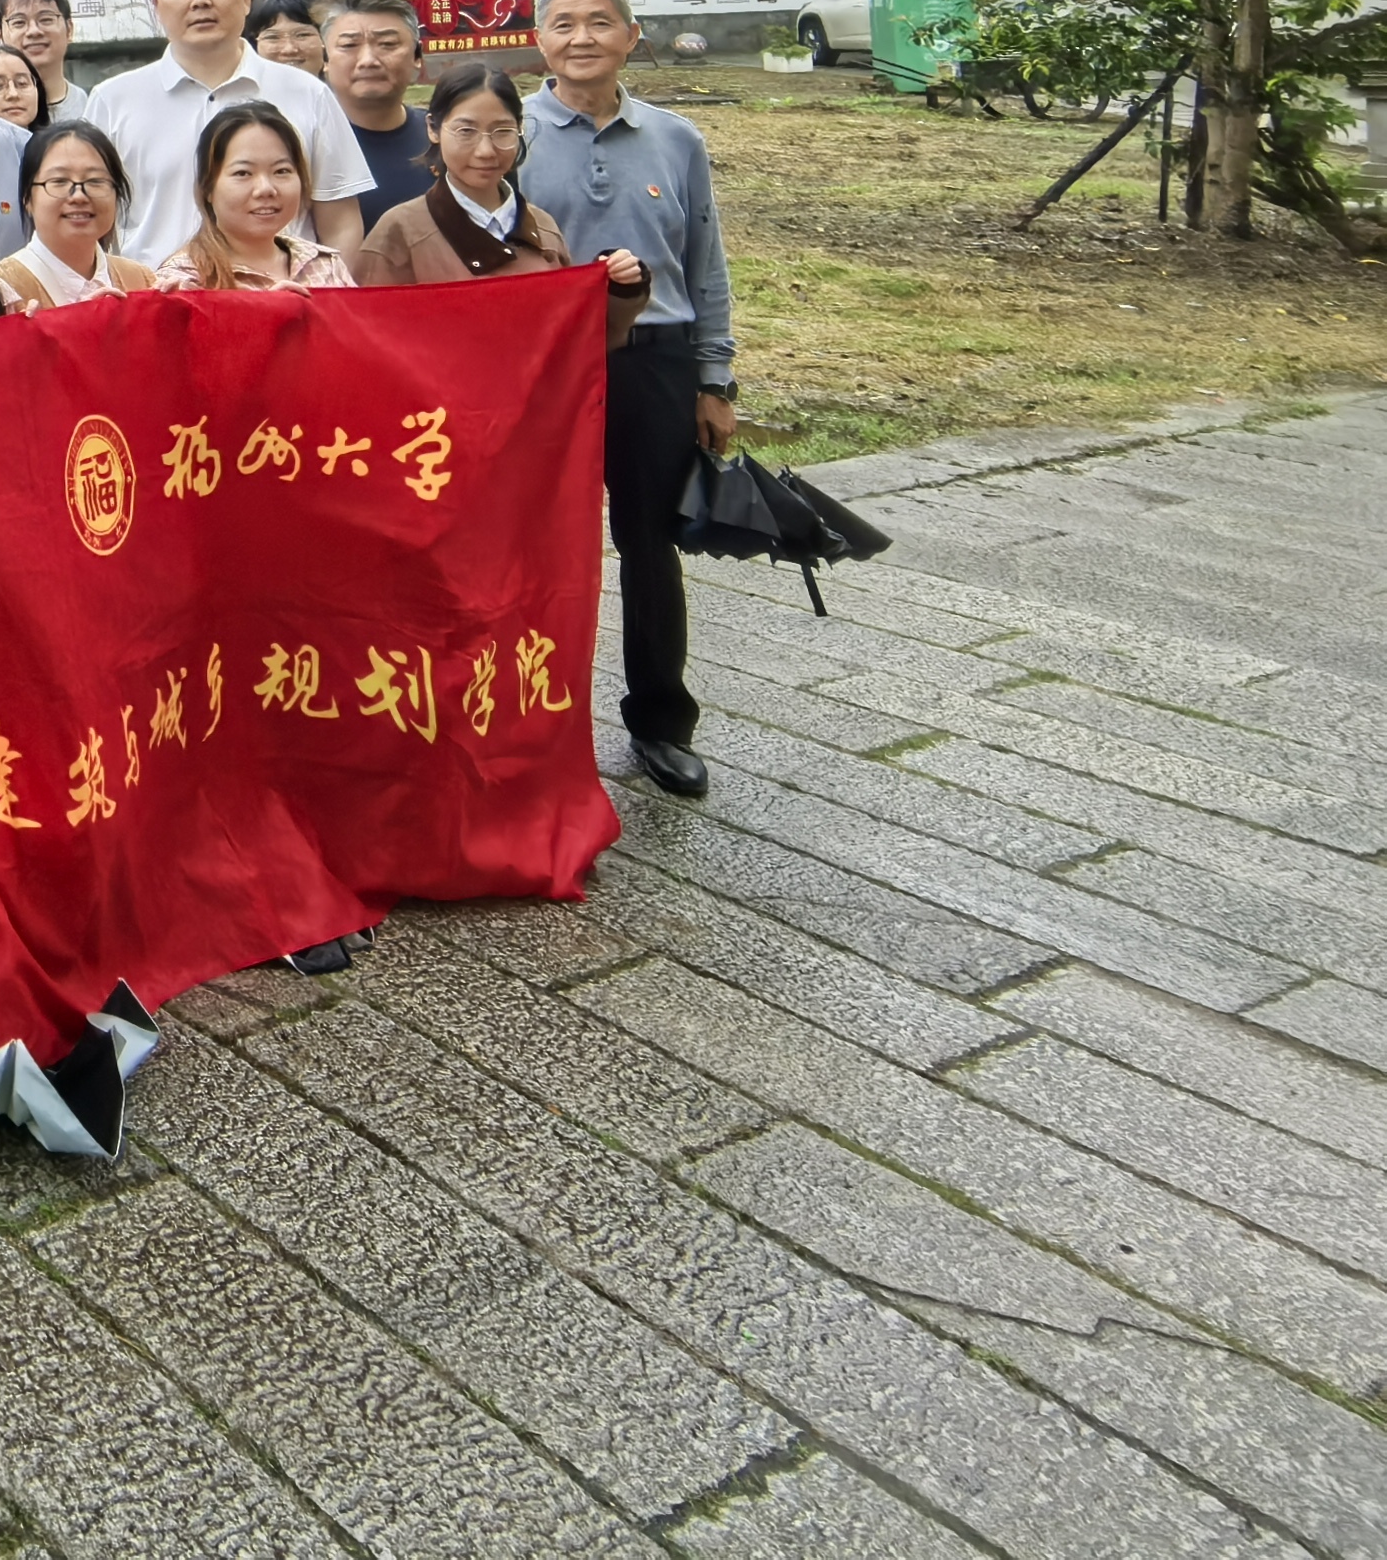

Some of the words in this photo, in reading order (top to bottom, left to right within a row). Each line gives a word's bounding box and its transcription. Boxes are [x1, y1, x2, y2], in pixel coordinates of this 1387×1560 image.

[432, 11, 452, 24] 法治
[428, 37, 474, 51] 国家有力量
[481, 34, 528, 47] 民族有希望
[161, 406, 452, 501] 福州大学
